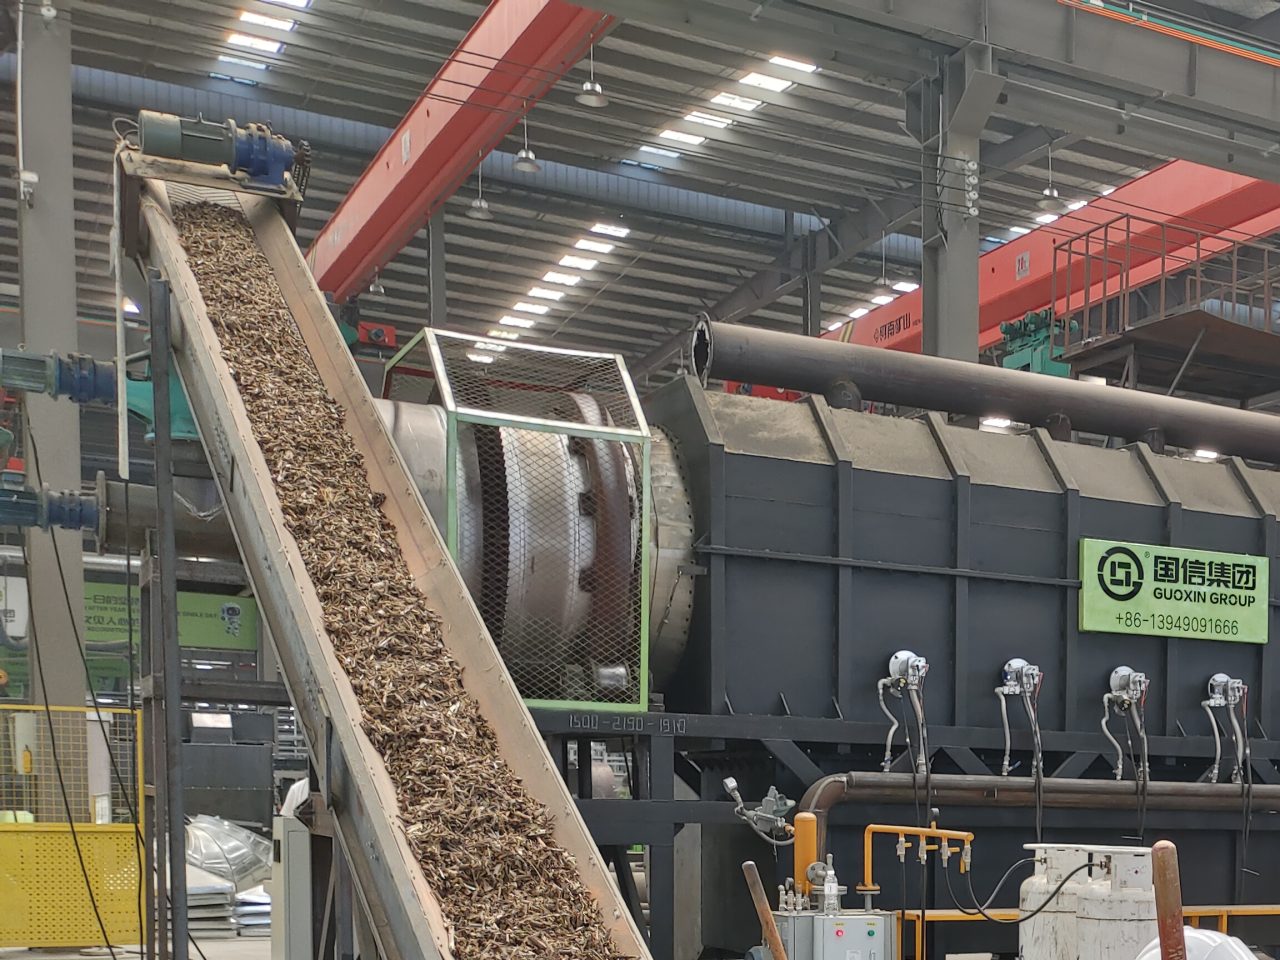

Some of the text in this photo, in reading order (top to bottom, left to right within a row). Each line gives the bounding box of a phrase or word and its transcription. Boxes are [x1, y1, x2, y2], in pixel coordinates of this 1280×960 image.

[1153, 555, 1257, 591] 国信集团
[1153, 587, 1256, 607] GUOXIN GROUP
[1115, 611, 1239, 636] +86-13949091666
